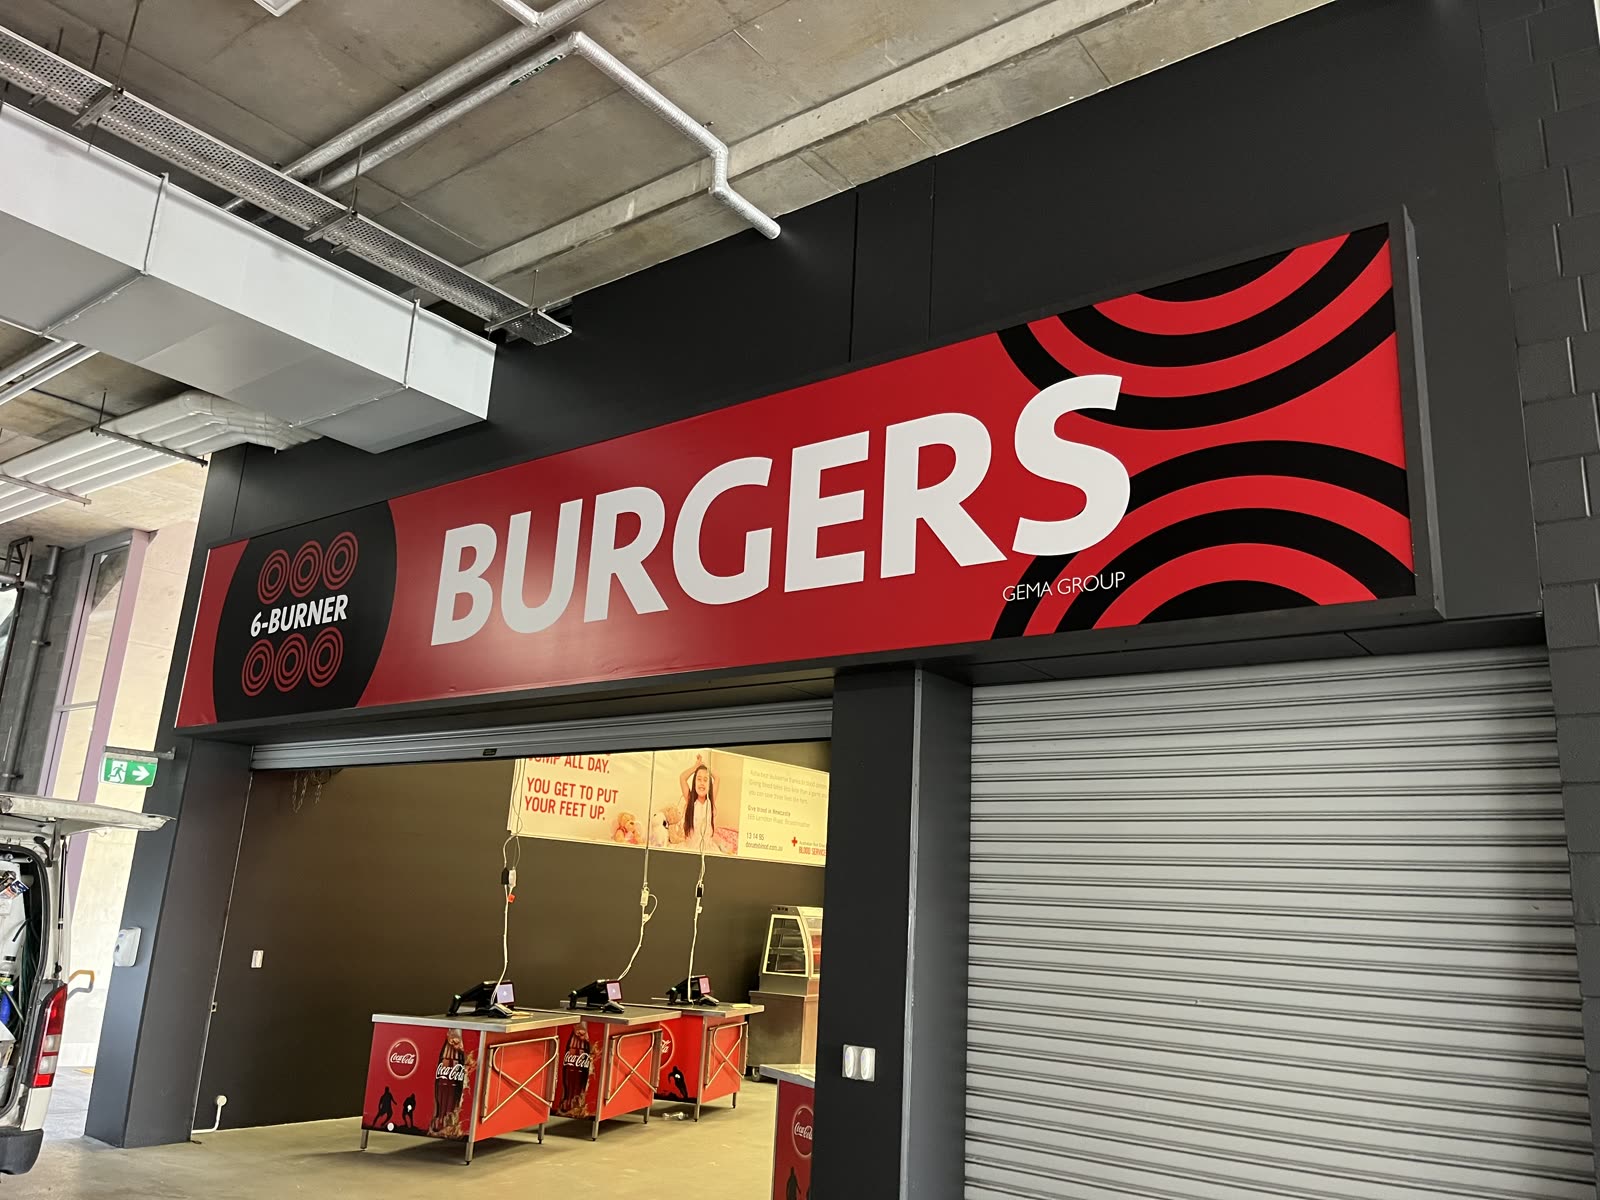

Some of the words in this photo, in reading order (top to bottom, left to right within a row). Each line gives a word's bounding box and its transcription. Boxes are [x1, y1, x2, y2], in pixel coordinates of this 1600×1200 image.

[431, 374, 1131, 646] BURGERS
[1002, 581, 1053, 602] GEMA
[1057, 571, 1126, 595] GROUP
[250, 594, 349, 637] 6-BURNER
[564, 754, 584, 770] ALL
[587, 756, 610, 774] DAY.
[527, 777, 551, 795] YOU
[554, 781, 576, 798] GET
[579, 785, 594, 801] TO
[596, 787, 619, 804] PUT
[525, 796, 556, 815] YOUR
[559, 800, 587, 818] FEET
[589, 804, 606, 821] UP.
[390, 1052, 416, 1065] Coca-Cola
[563, 1050, 591, 1069] Coca-Cola
[436, 1062, 465, 1081] Coca-Cola
